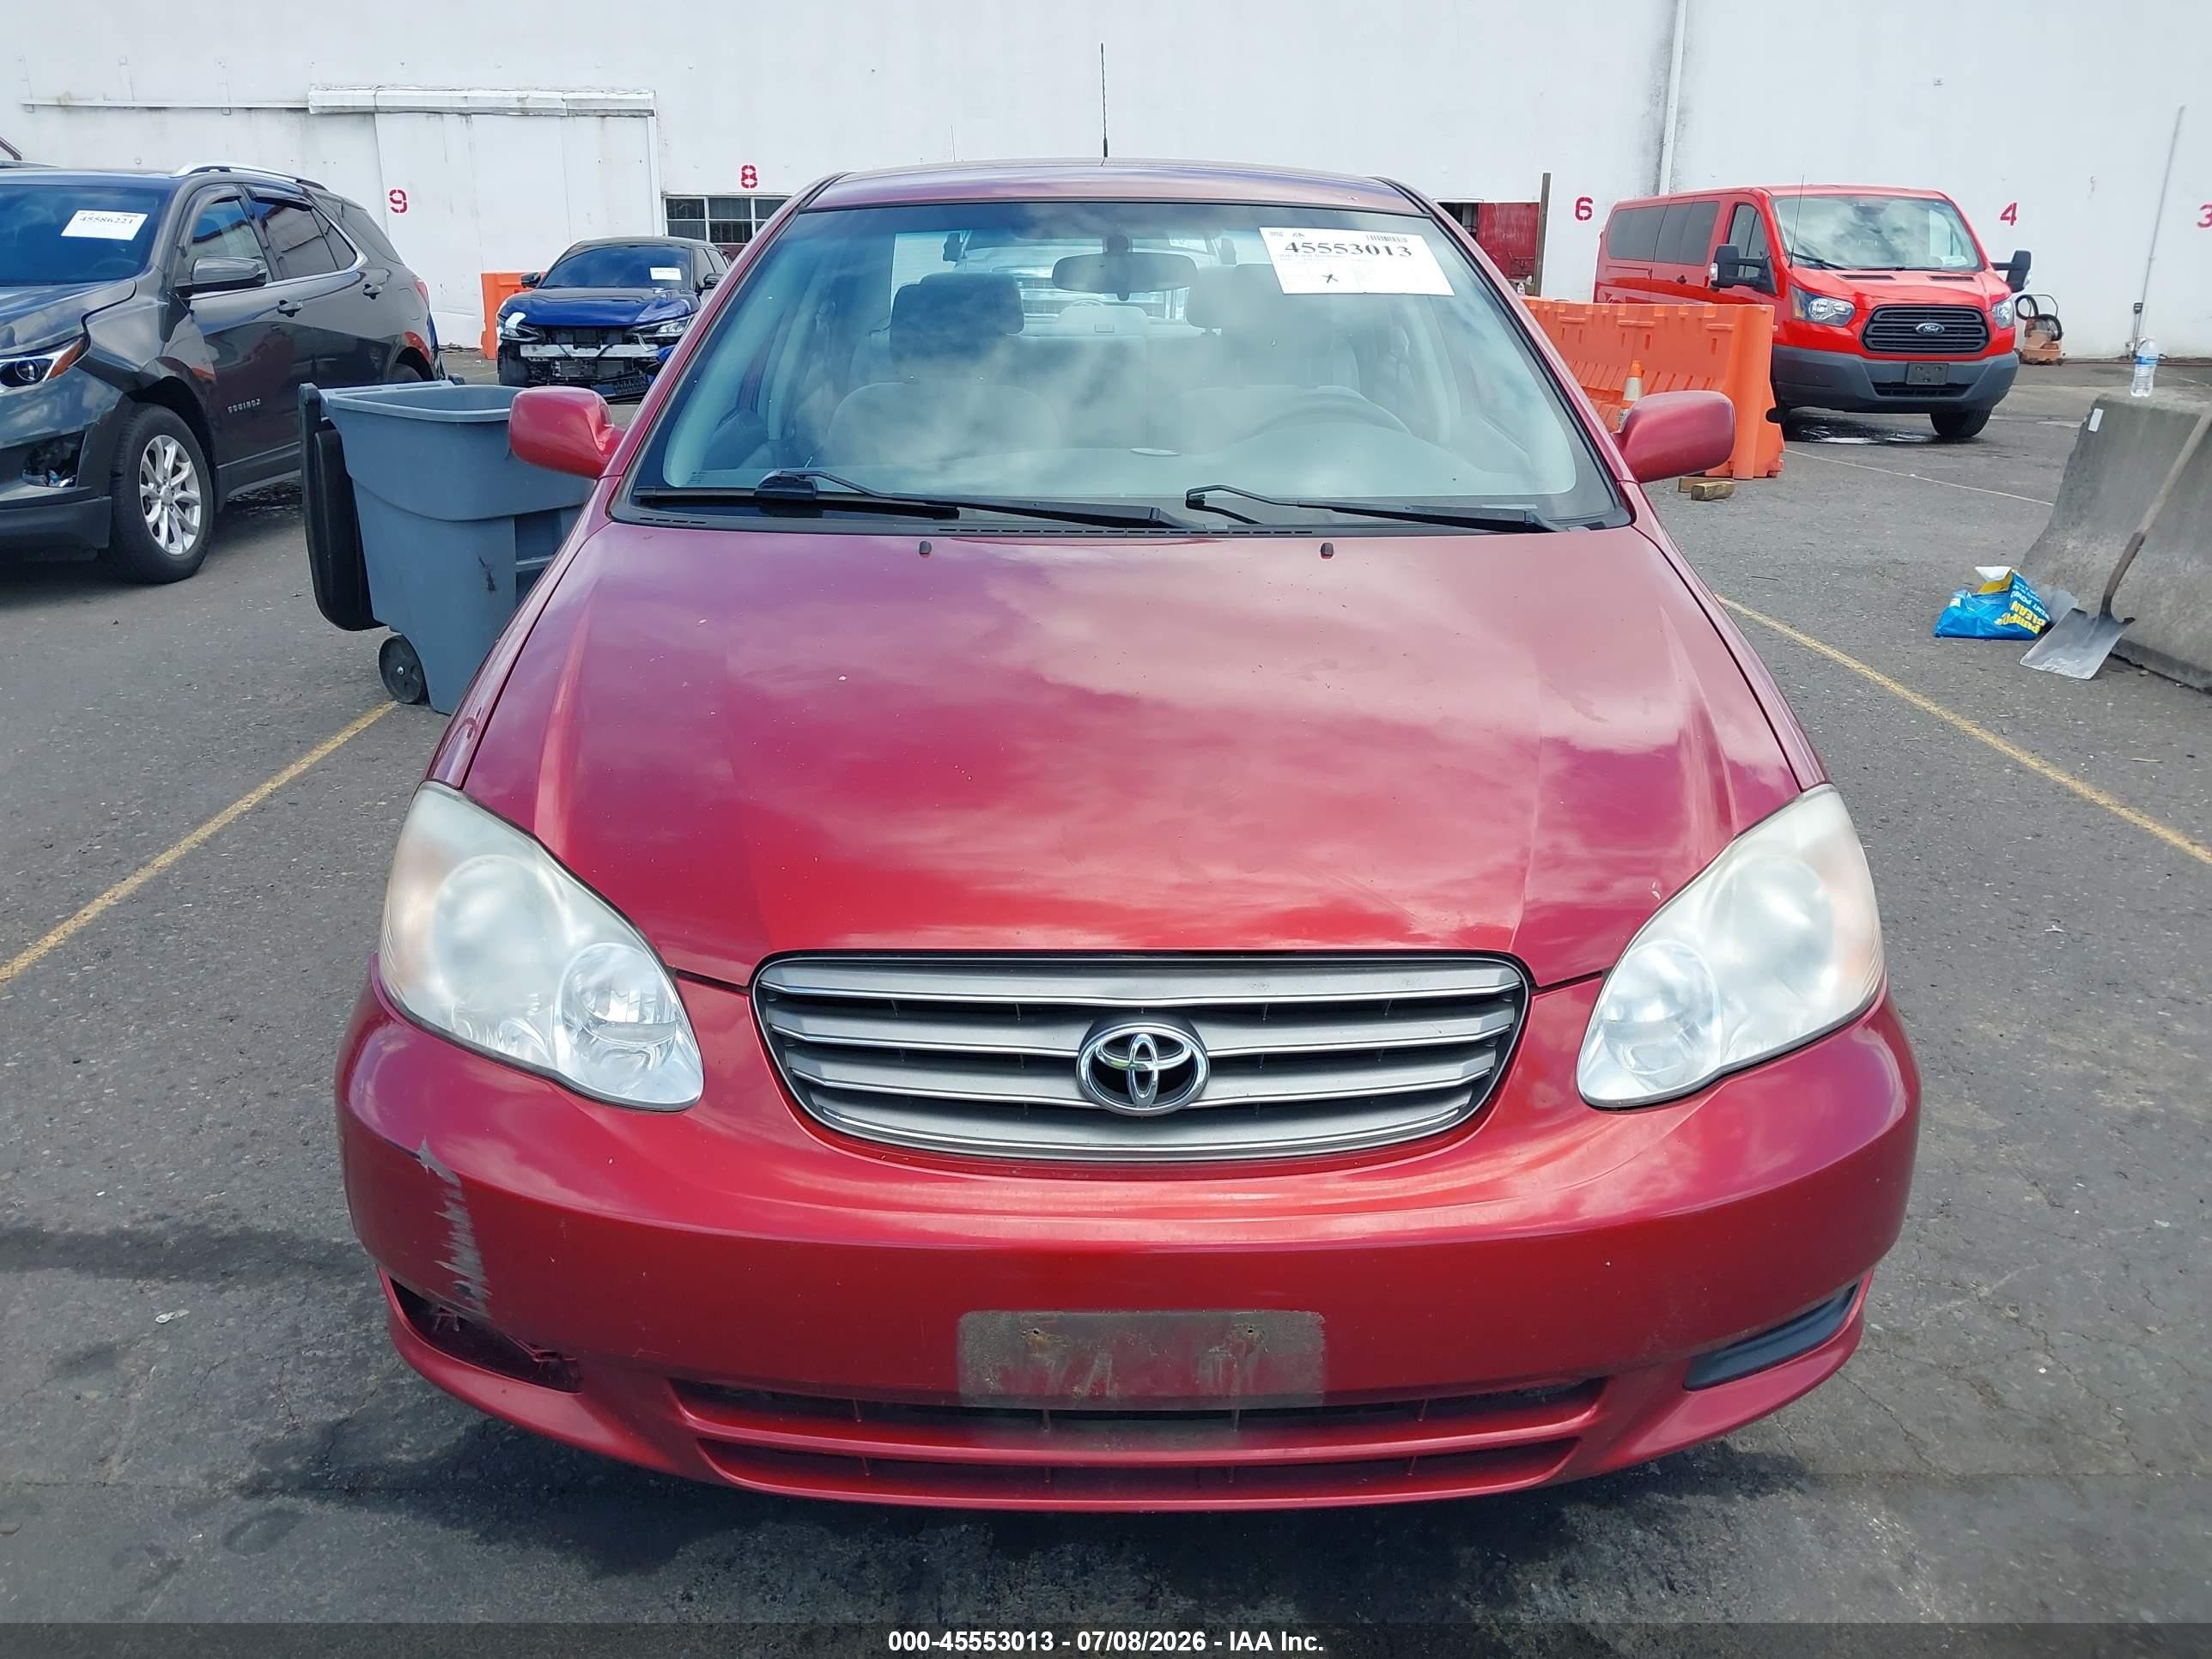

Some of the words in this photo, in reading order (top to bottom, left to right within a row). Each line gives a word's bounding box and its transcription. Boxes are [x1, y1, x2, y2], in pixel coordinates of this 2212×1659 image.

[741, 165, 758, 188] 8
[390, 189, 408, 213] 9
[1575, 197, 1593, 222] 6
[2000, 203, 2018, 225] 4
[1285, 241, 1413, 257] 45553013
[2010, 600, 2046, 626] CLEAN
